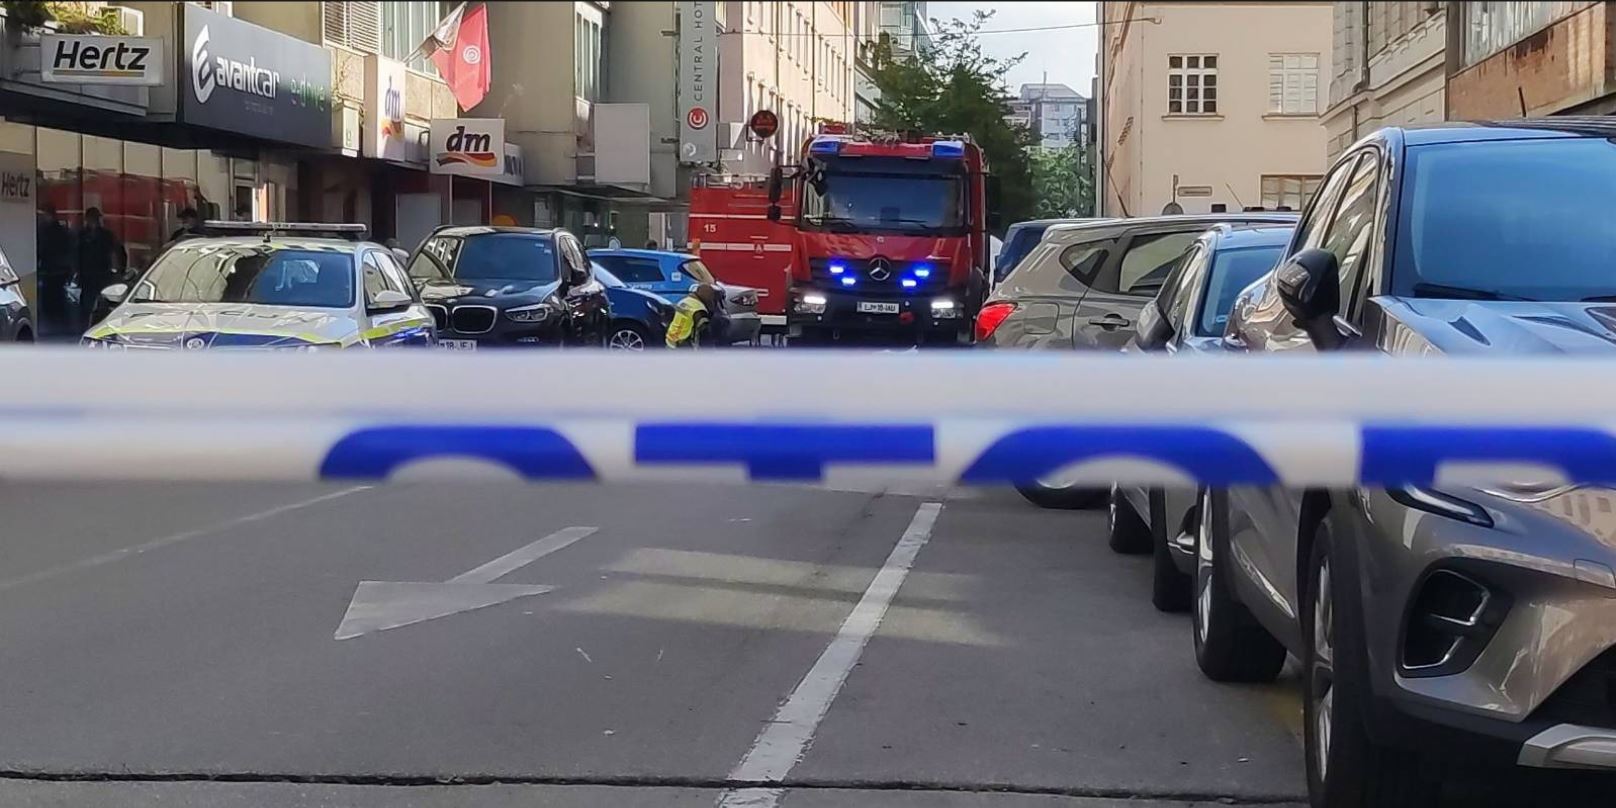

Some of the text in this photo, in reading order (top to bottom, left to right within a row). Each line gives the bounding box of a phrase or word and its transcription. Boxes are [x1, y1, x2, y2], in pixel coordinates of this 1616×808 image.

[53, 41, 149, 70] Hertz
[694, 37, 703, 101] CENTRAL
[216, 56, 279, 98] avantcar
[385, 75, 400, 119] dm
[446, 126, 491, 152] dm
[2, 172, 29, 197] Hertz
[704, 224, 716, 232] 15
